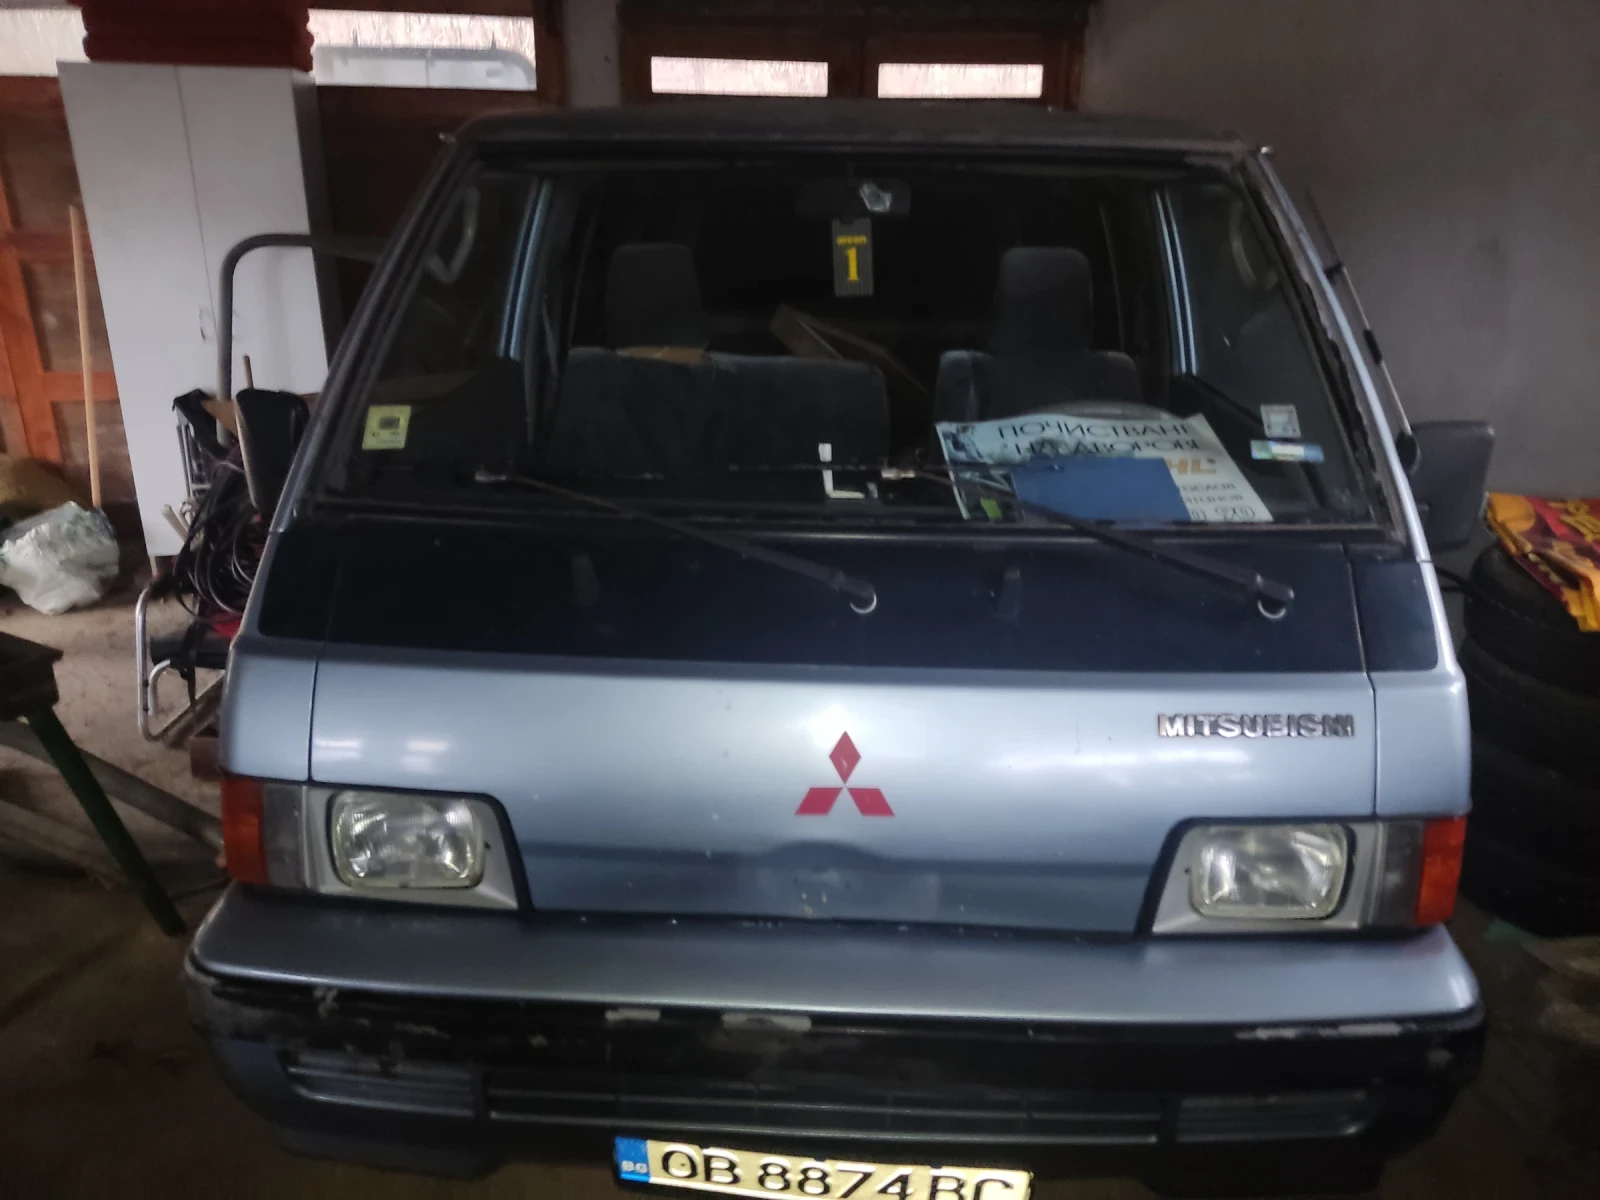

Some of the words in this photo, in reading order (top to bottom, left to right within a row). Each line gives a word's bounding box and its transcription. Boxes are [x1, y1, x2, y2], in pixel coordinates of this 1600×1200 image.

[845, 247, 859, 281] 1
[1157, 713, 1355, 738] MITSUBISHI
[661, 1146, 742, 1185] OB
[757, 1157, 914, 1200] 8874
[928, 1170, 1015, 1200] BC
